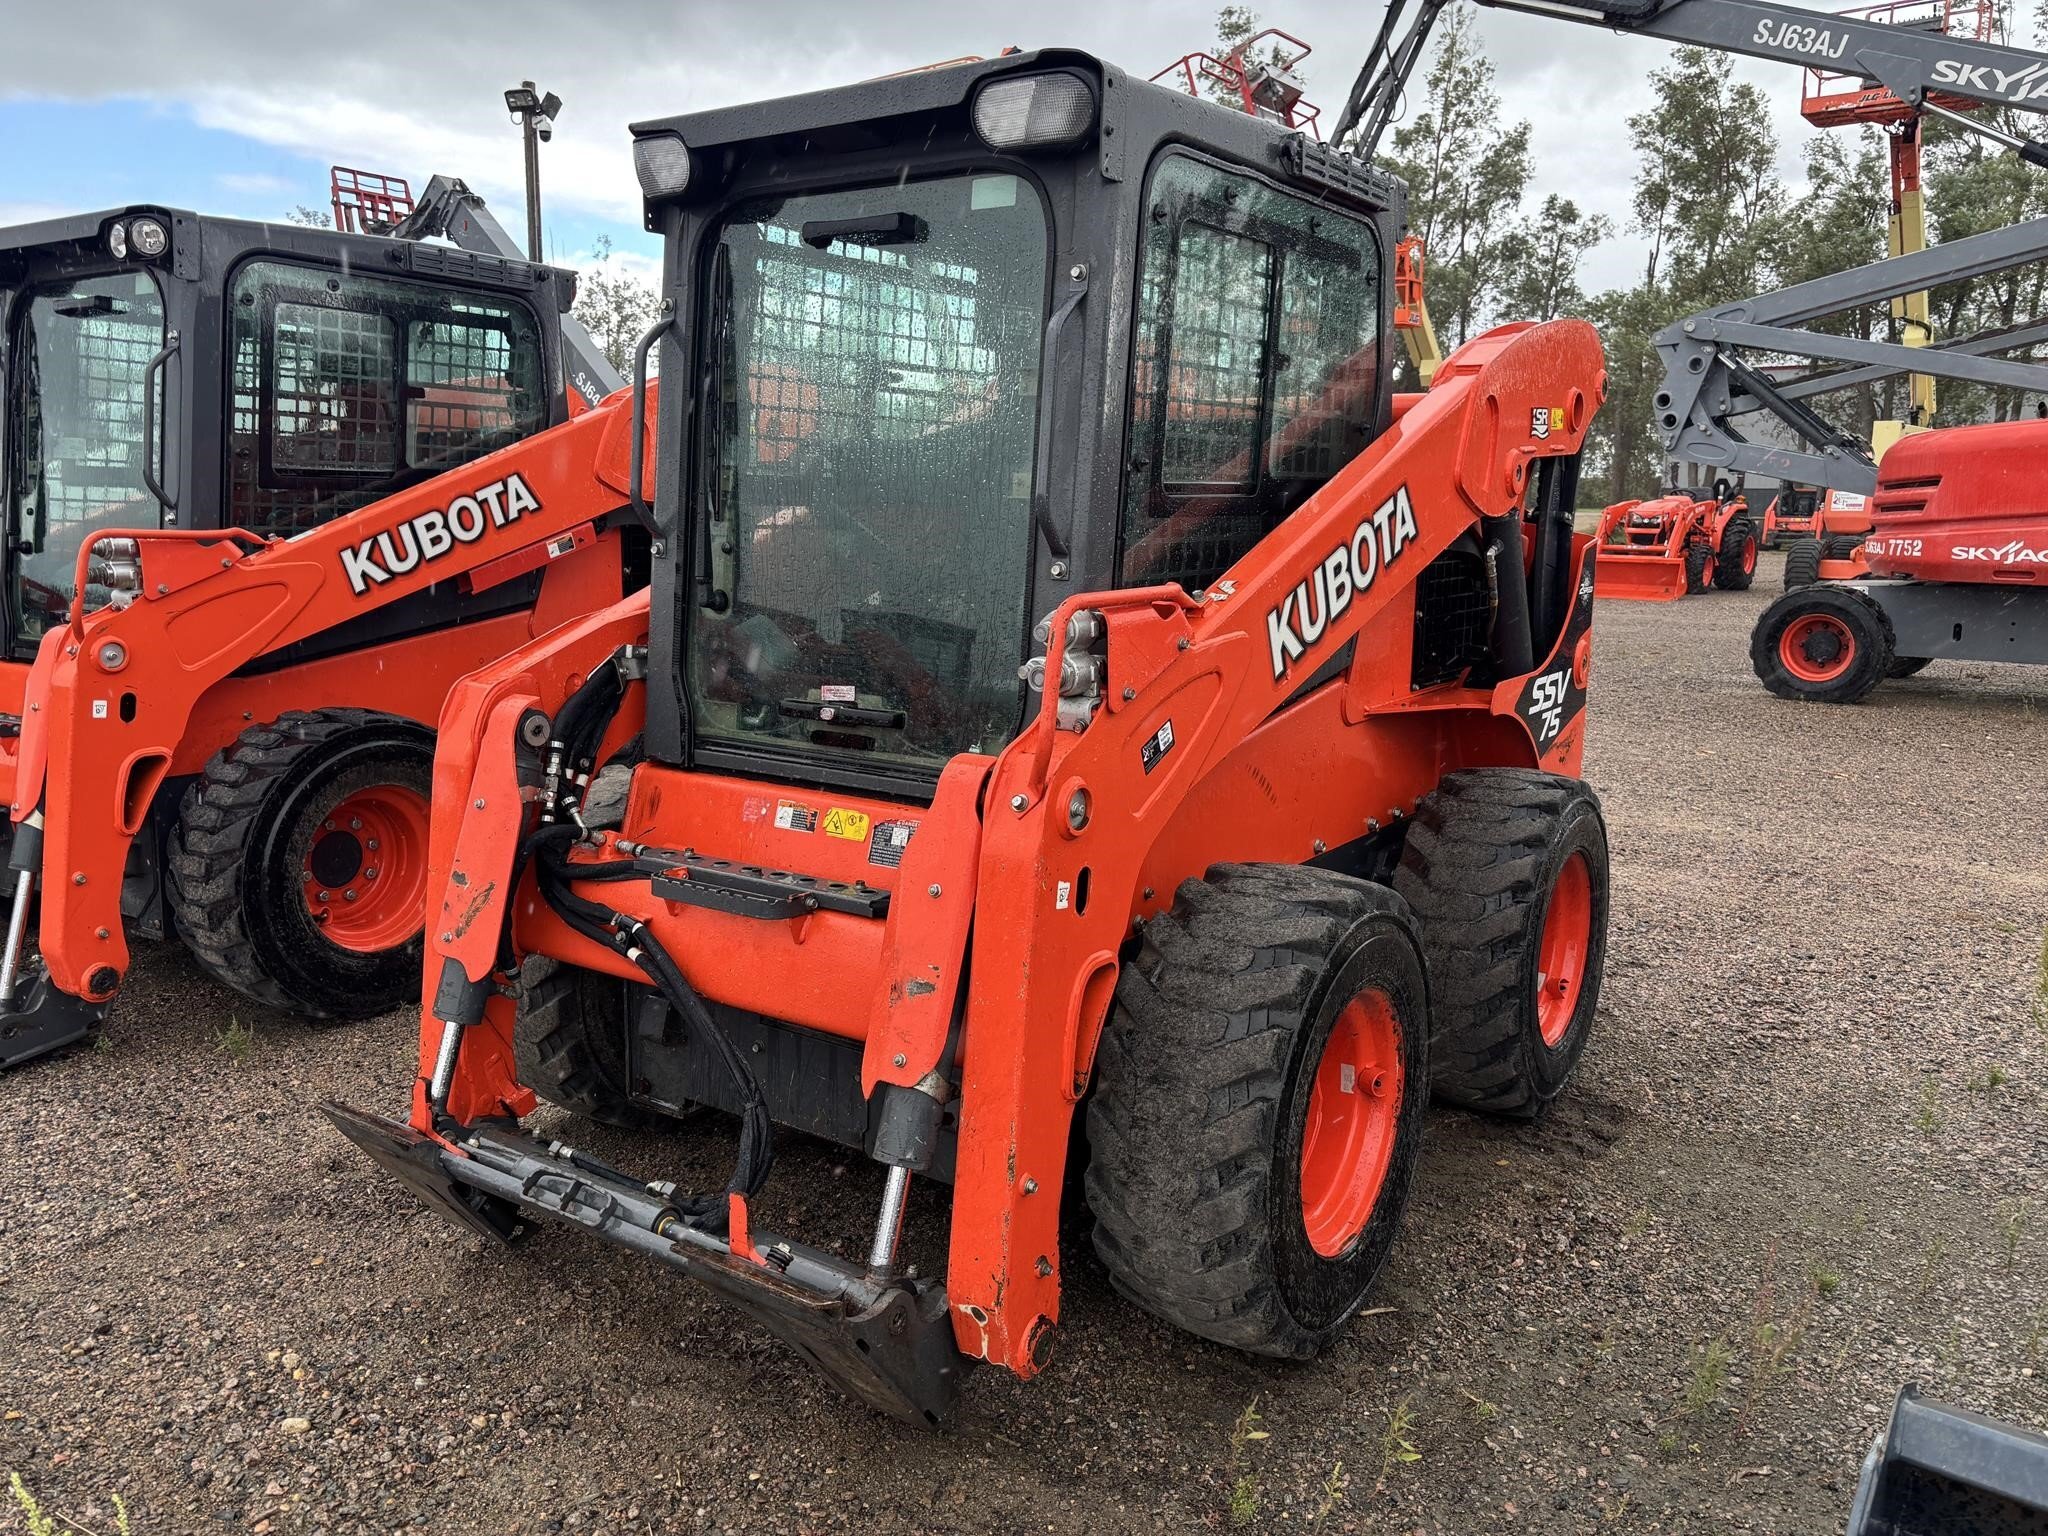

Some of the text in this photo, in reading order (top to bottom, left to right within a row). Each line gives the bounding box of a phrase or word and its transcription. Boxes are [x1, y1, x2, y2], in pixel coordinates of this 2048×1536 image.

[1753, 18, 1850, 59] SJ63AJ
[1859, 93, 1880, 103] JLG
[339, 473, 541, 595] KUBOTA
[1888, 539, 1922, 556] 7752
[1267, 485, 1418, 681] KUBOTA
[1528, 667, 1572, 715] SSV
[1539, 706, 1562, 742] 75
